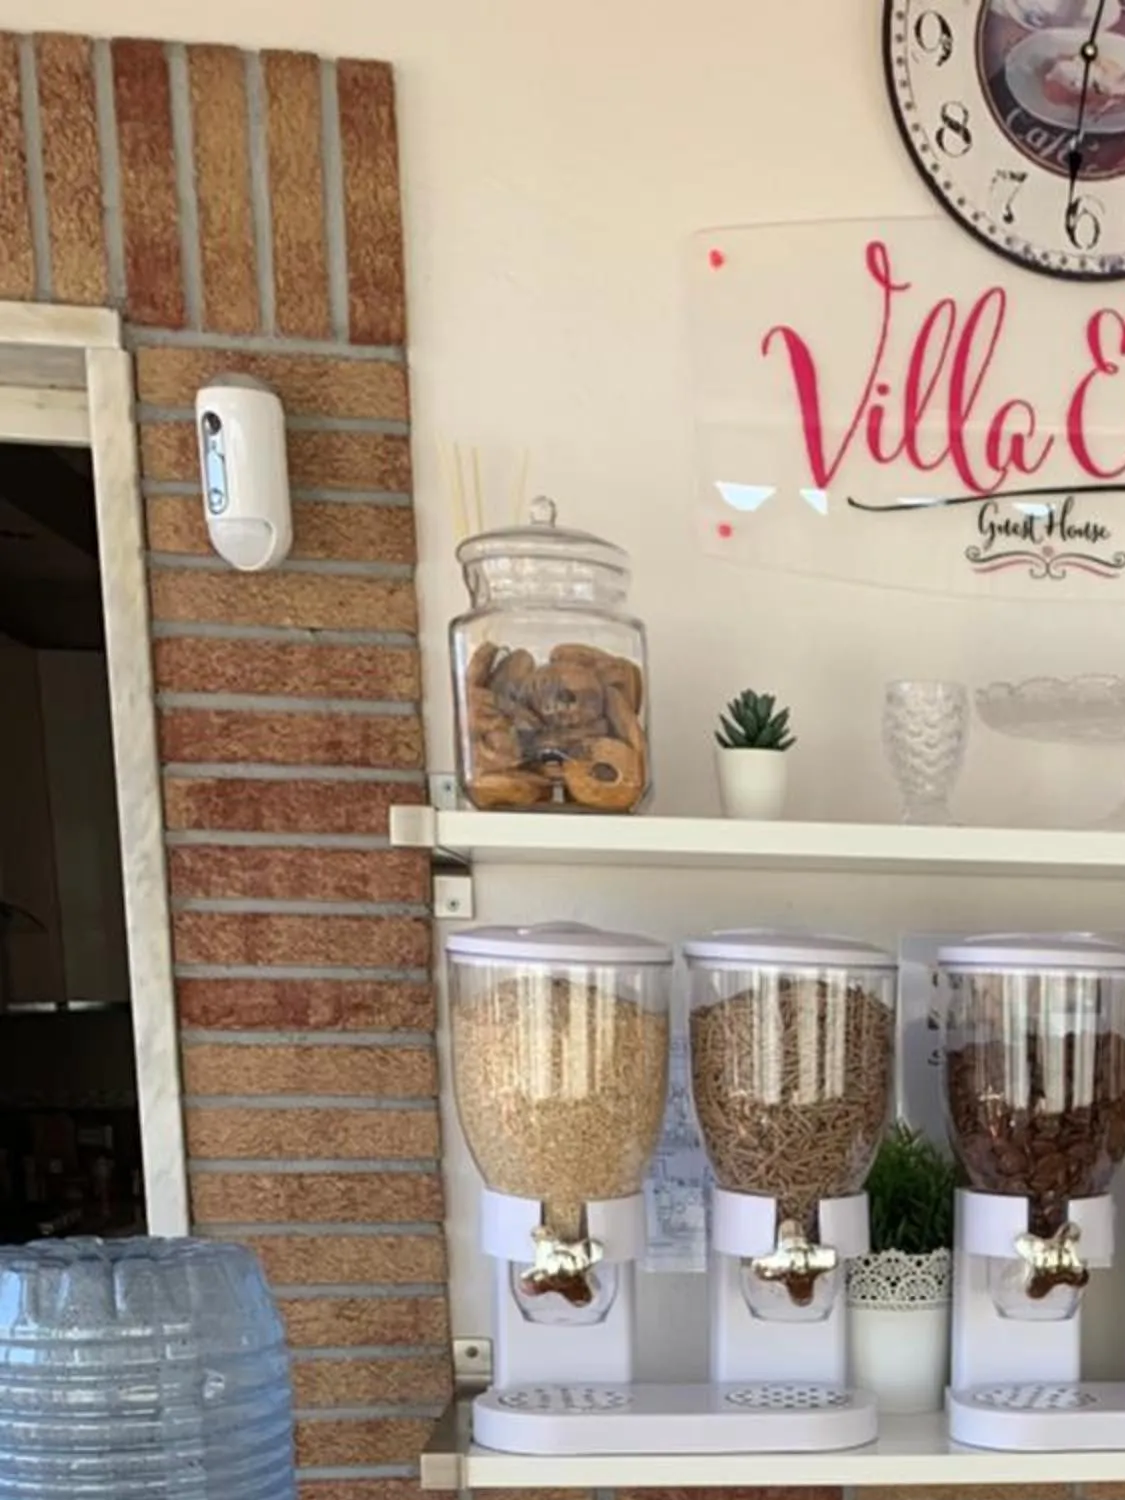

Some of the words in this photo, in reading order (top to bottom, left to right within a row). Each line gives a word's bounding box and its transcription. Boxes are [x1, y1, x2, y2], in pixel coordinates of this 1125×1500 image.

[914, 10, 953, 67] 9
[935, 101, 973, 157] 8
[1065, 194, 1106, 250] 6
[762, 241, 1054, 494] Villa
[977, 500, 1045, 551] Guest
[1045, 495, 1113, 544] House
